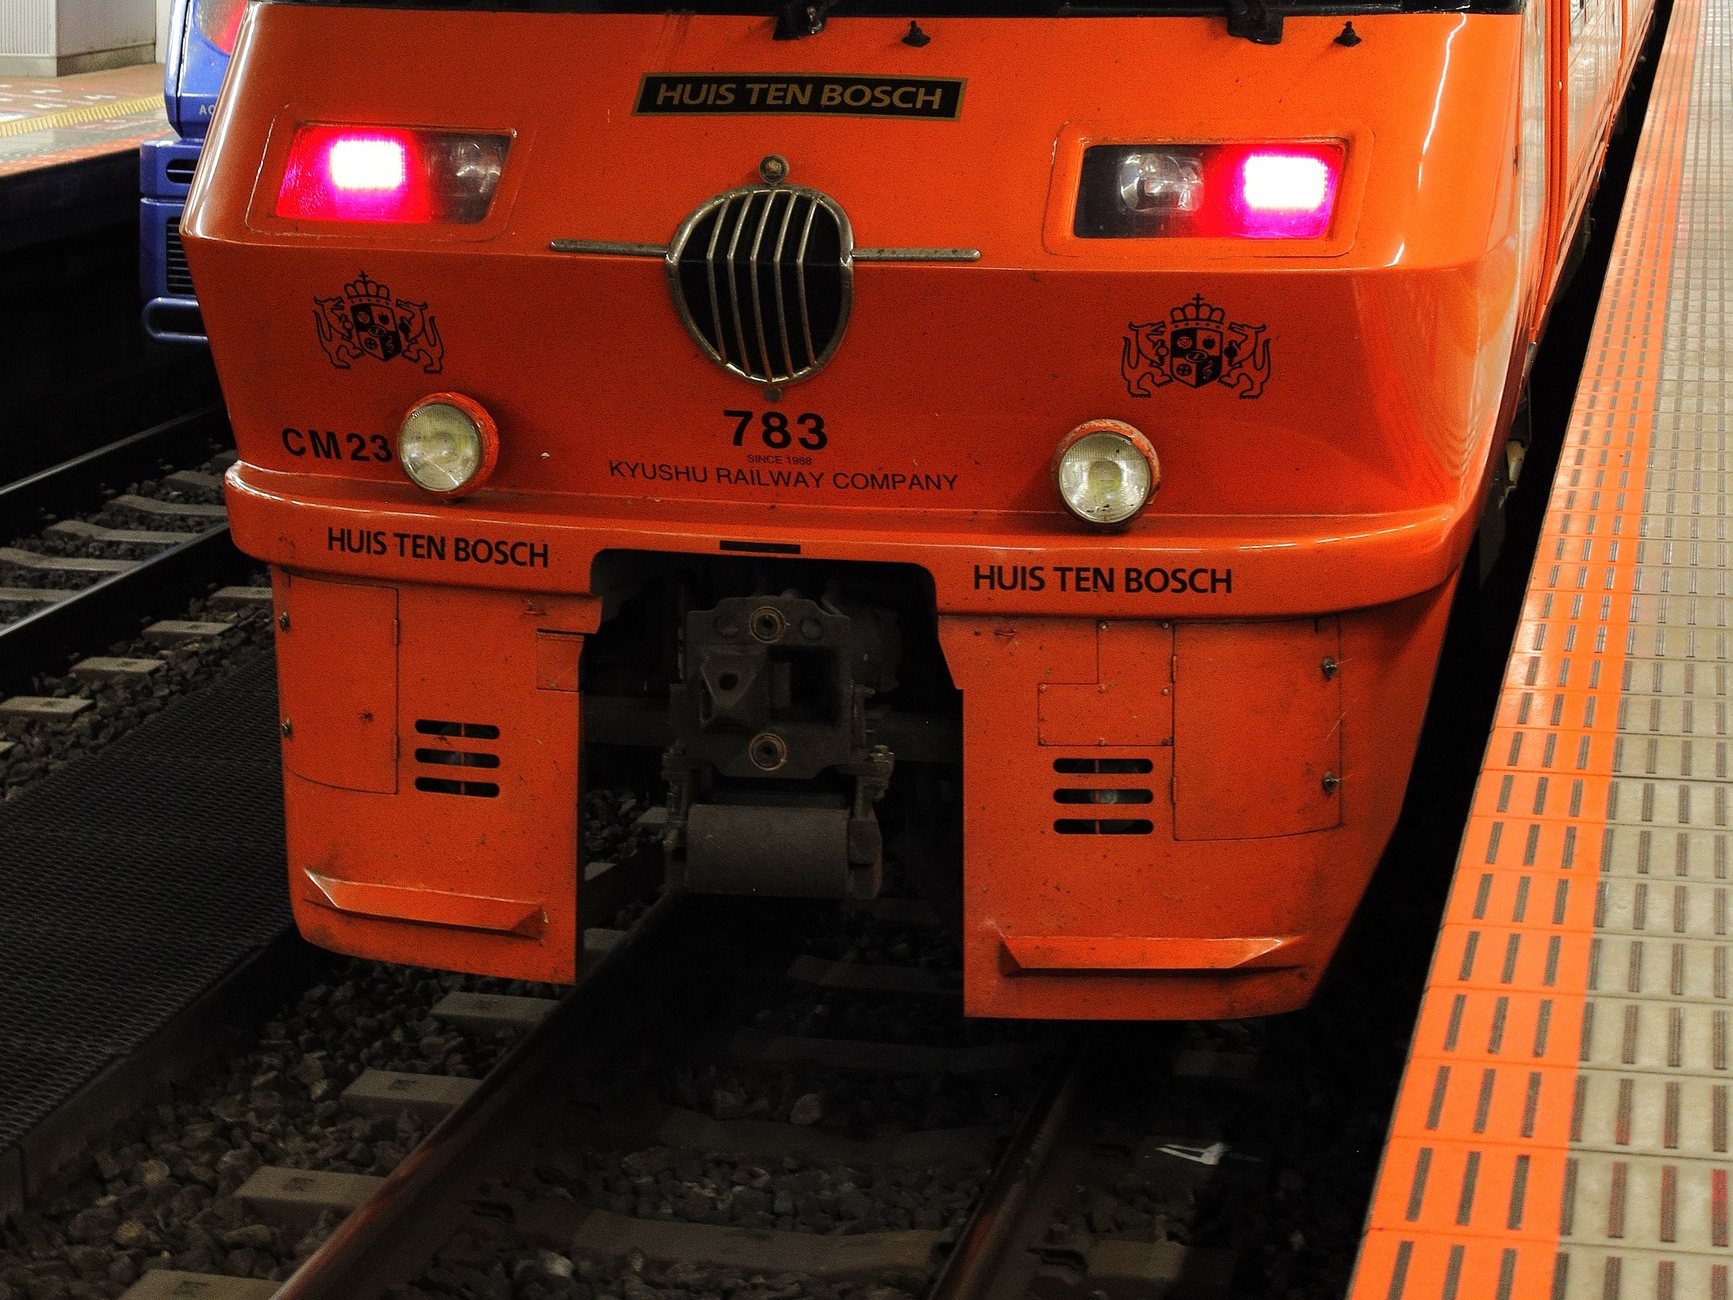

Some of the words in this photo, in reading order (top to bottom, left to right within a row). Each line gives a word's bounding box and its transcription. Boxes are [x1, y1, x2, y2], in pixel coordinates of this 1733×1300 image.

[655, 83, 737, 106] HUIS
[746, 83, 813, 106] TEN
[820, 85, 943, 109] BOSCH
[281, 427, 393, 463] CM23
[723, 409, 828, 451] 783
[609, 460, 708, 483] KYUSHU
[716, 467, 824, 489] RAILWAY
[832, 472, 959, 491] COMPANY
[746, 454, 783, 465] SINCE
[786, 456, 813, 466] 1988
[327, 526, 387, 555] HUIS
[393, 532, 446, 561] TEN
[453, 537, 549, 568] BOSCH
[973, 564, 1046, 592] HUIS
[1053, 566, 1115, 593] TEN
[1125, 567, 1232, 594] BOSCH
